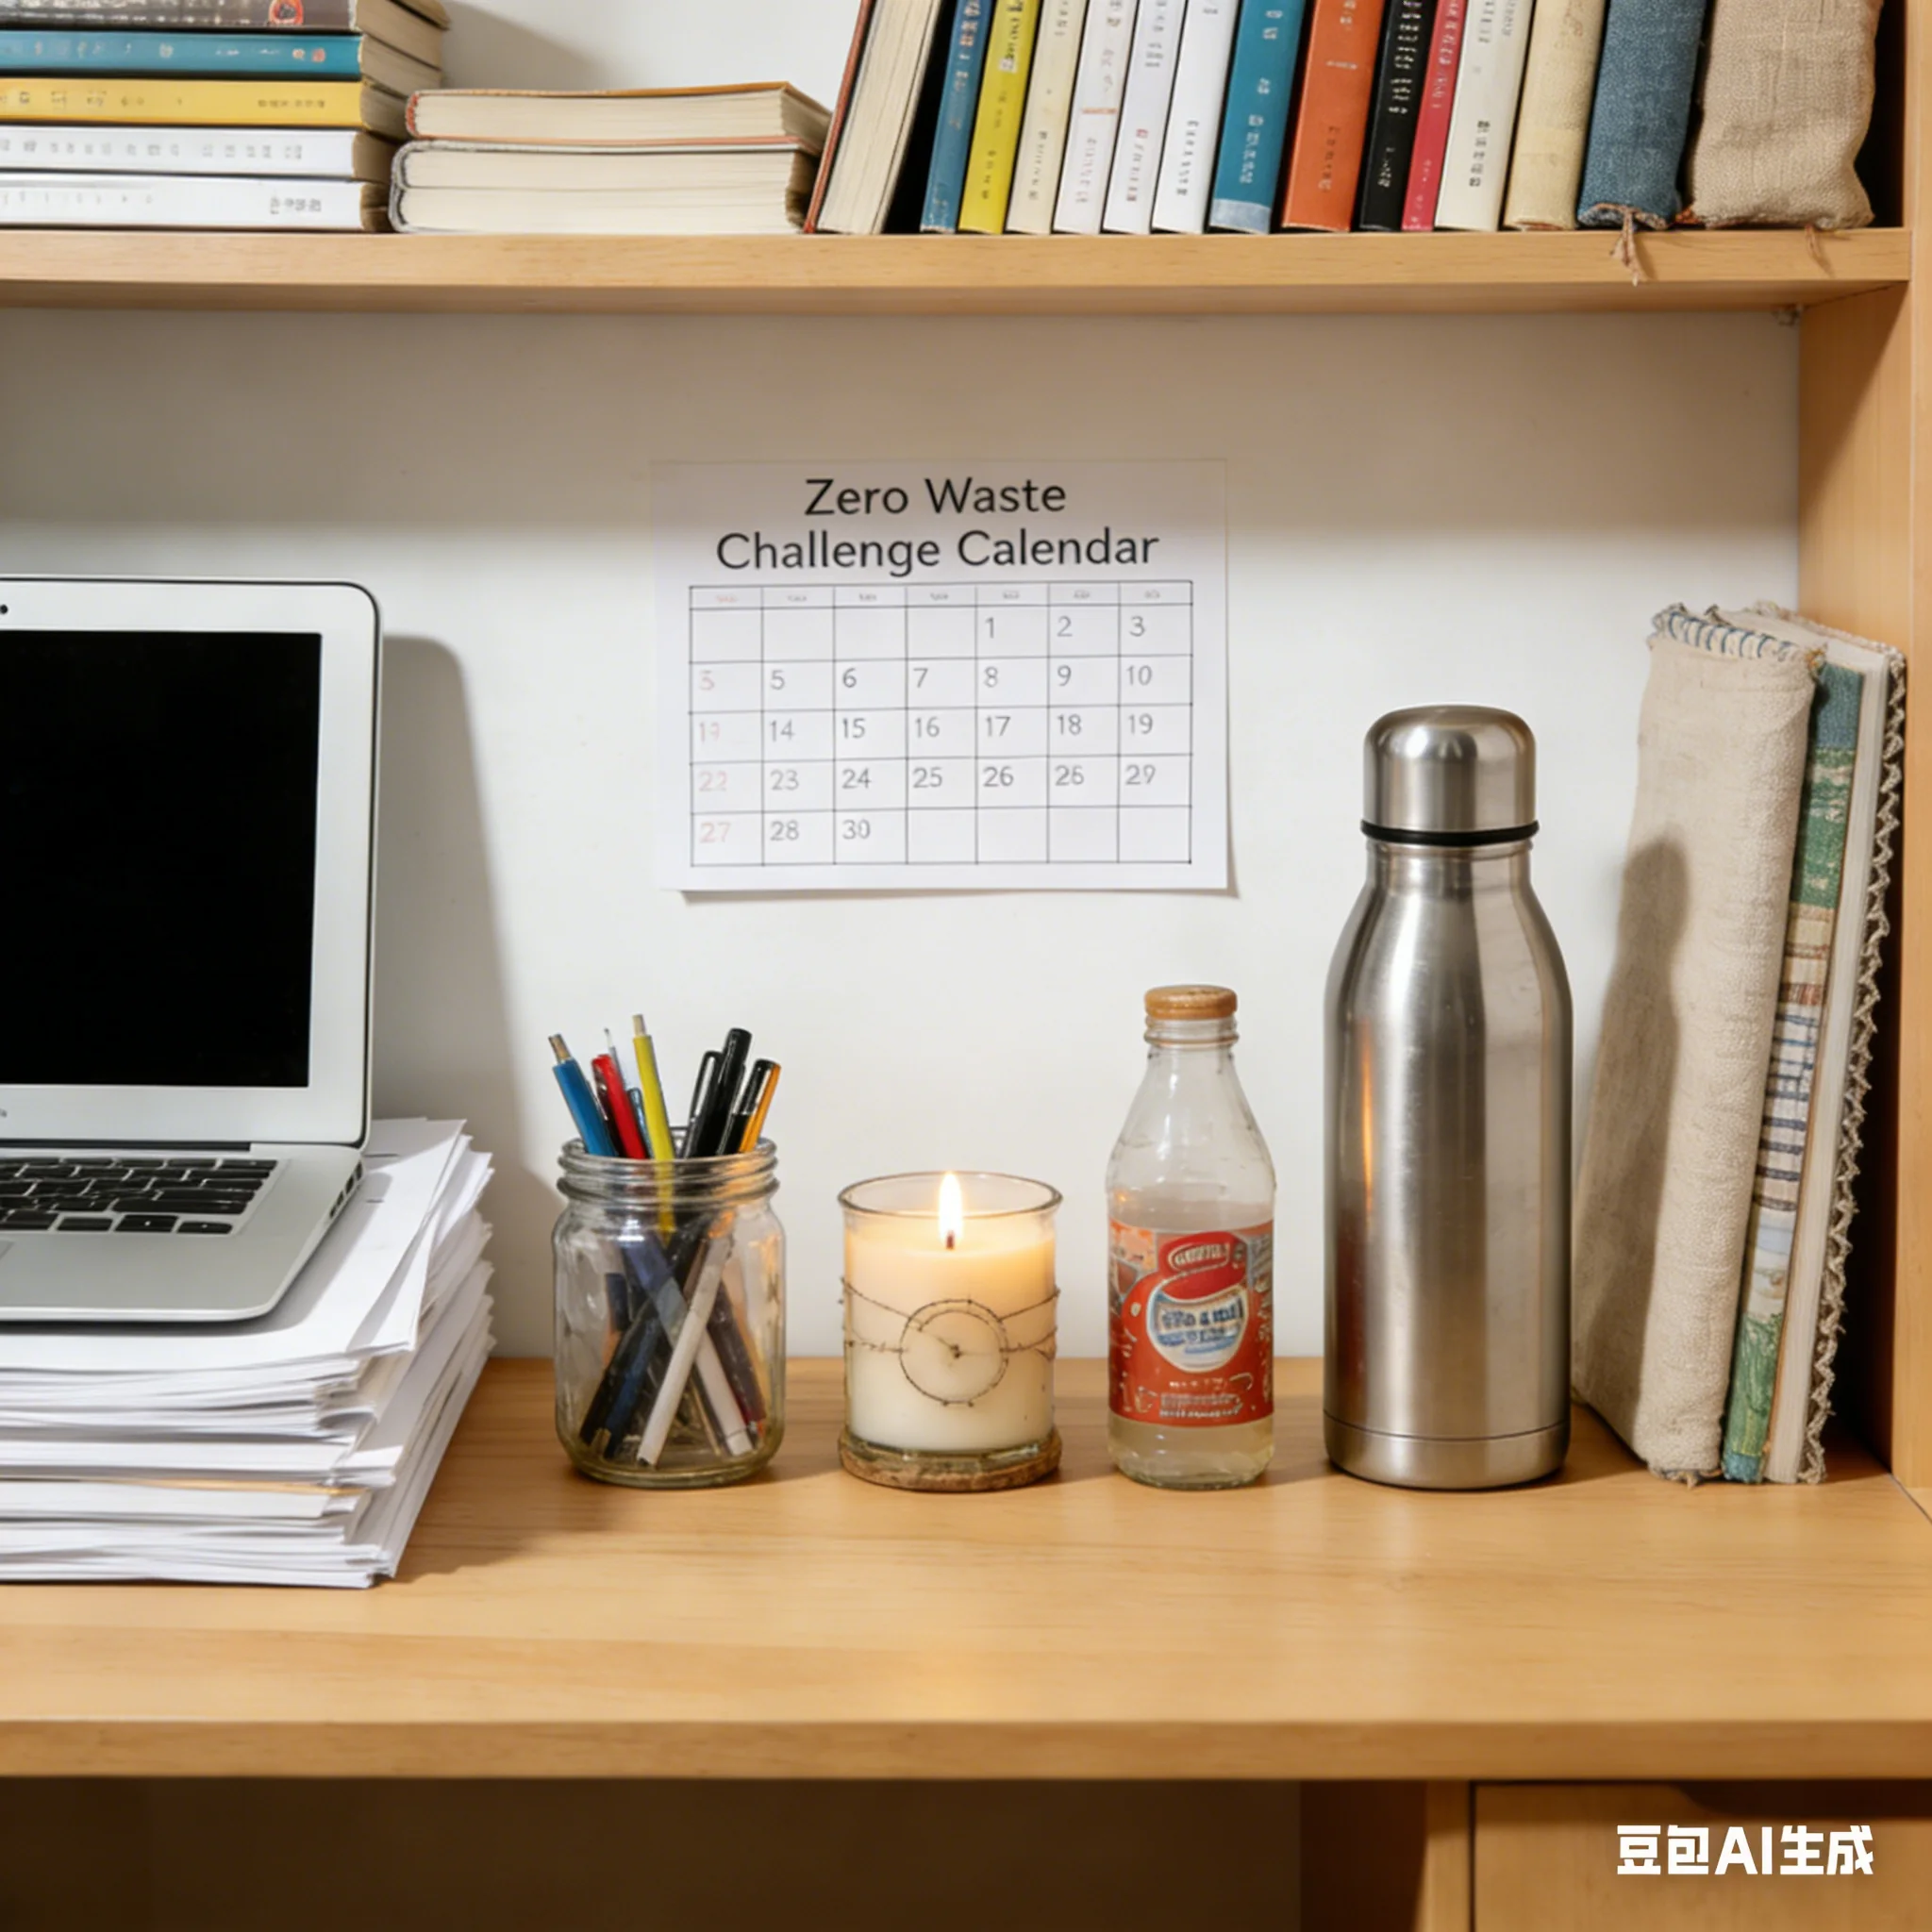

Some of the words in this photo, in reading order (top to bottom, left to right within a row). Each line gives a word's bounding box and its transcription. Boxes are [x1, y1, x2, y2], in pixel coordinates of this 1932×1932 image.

[804, 478, 909, 516] Zero
[924, 476, 1067, 514] Waste
[716, 529, 941, 578] Challenge
[958, 526, 1159, 566] Calendar
[984, 616, 995, 639] 1
[1057, 615, 1073, 638] 2
[1128, 615, 1146, 638] 3
[770, 669, 786, 691] 5
[841, 667, 858, 689] 6
[913, 667, 929, 689] 7
[984, 666, 1000, 688] 8
[1057, 664, 1073, 687] 9
[1126, 664, 1153, 686] 10
[770, 719, 794, 741] 14
[841, 717, 866, 740] 15
[915, 716, 941, 739] 16
[985, 715, 1011, 737] 17
[1057, 713, 1082, 736] 18
[1127, 712, 1154, 735] 19
[770, 769, 800, 791] 23
[841, 768, 872, 790] 24
[912, 766, 943, 789] 25
[983, 765, 1014, 788] 26
[699, 822, 731, 843] 27
[770, 819, 800, 841] 28
[842, 818, 872, 841] 30
